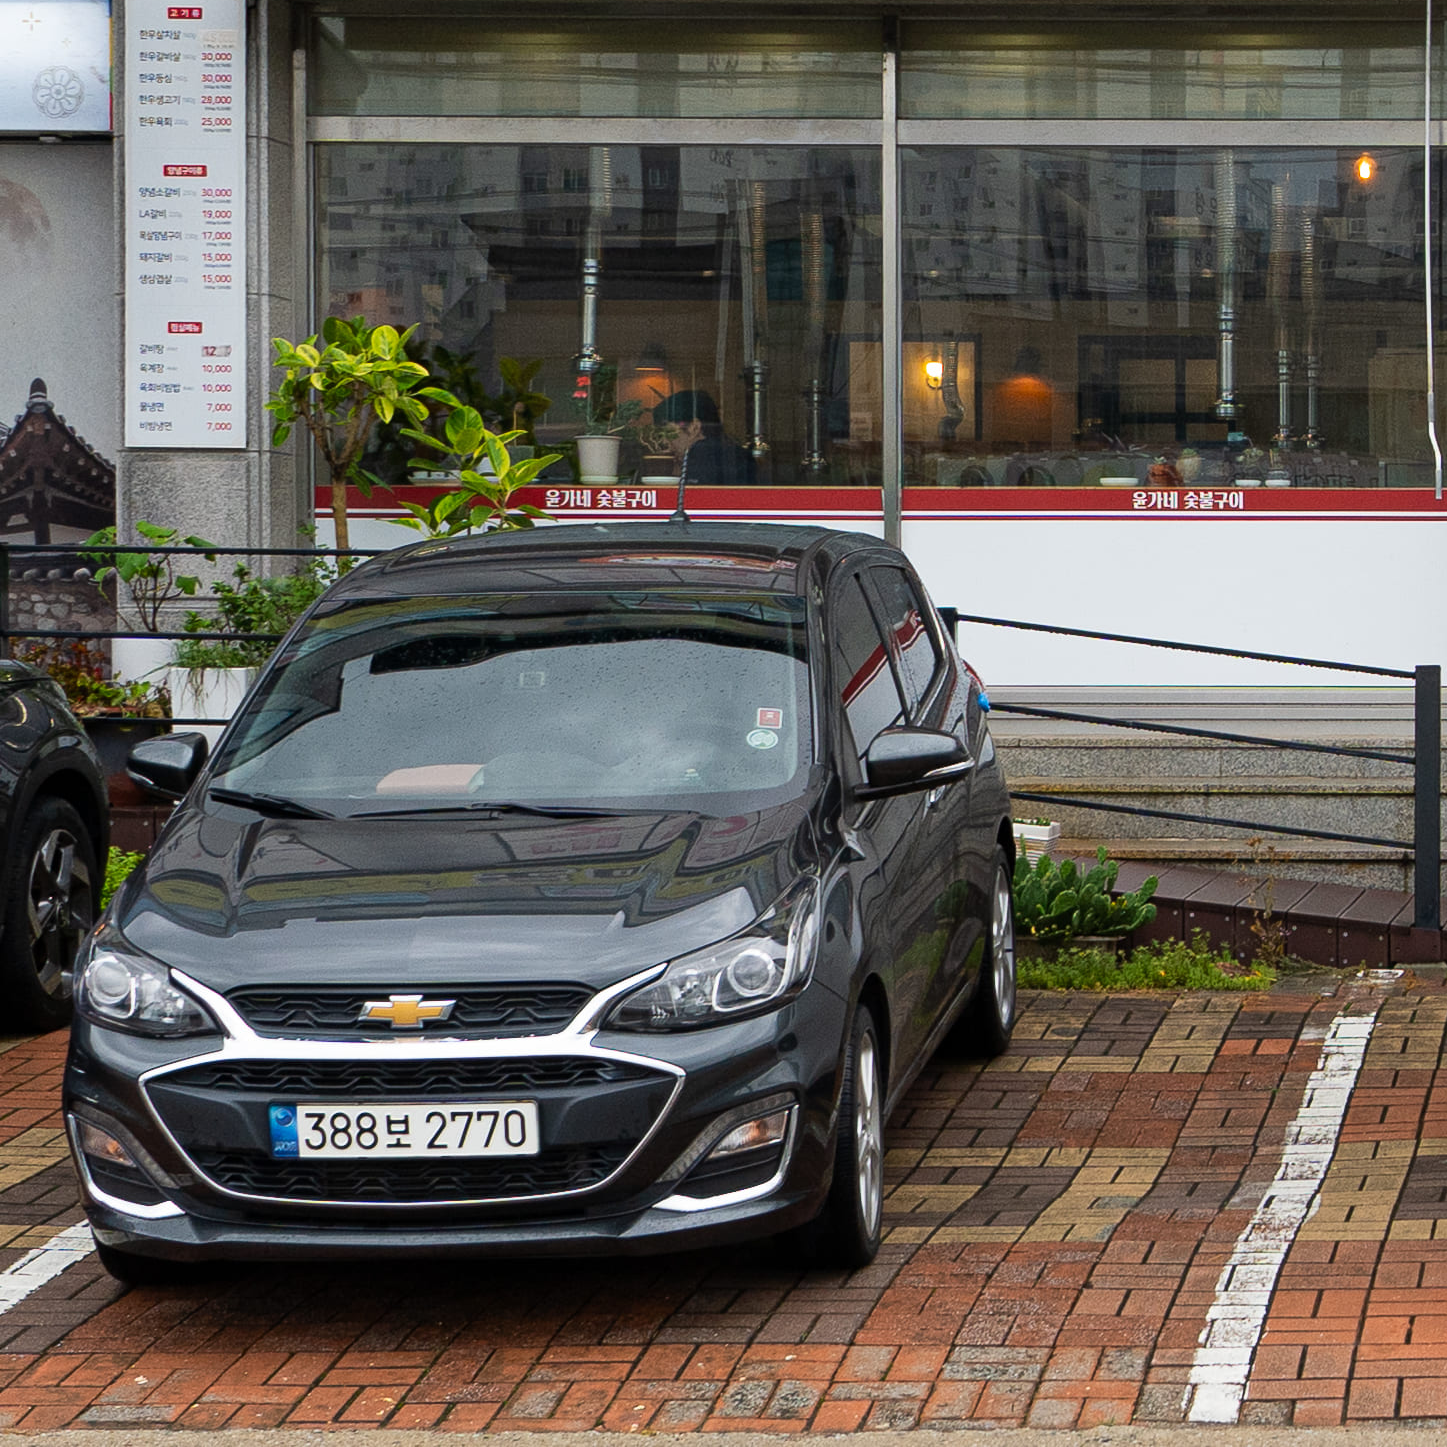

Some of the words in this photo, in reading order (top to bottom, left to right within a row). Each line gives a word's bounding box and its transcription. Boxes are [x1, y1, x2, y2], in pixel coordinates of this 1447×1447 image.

[545, 490, 592, 508] 윤가네
[596, 490, 657, 508] 숯불구이
[1132, 491, 1179, 509] 윤가네
[1183, 491, 1244, 509] 숯불구이
[304, 1111, 412, 1151] 388보
[425, 1109, 526, 1149] 2770
